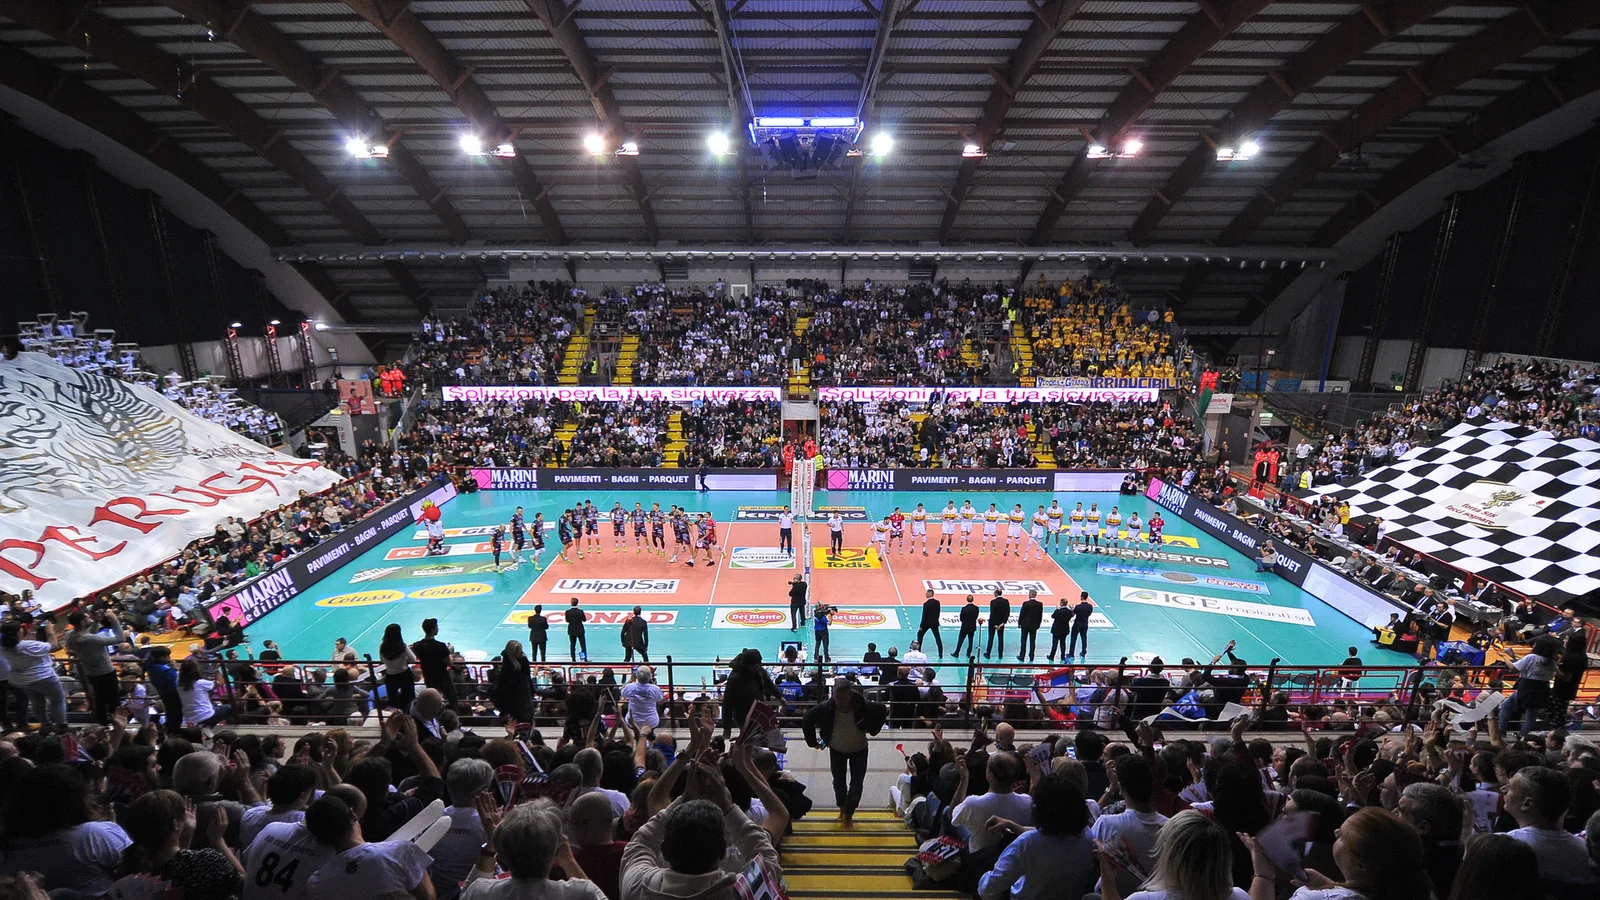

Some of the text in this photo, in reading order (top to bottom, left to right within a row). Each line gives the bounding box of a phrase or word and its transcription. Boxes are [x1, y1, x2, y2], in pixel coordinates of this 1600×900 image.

[1091, 377, 1179, 389] IRRIDUCIBILI
[449, 387, 775, 401] Soluzioni per la tua sicurezza
[825, 388, 926, 400] Soluzioni
[982, 388, 999, 400] la
[1005, 388, 1040, 400] tua
[1047, 388, 1152, 400] sicurezza
[491, 469, 538, 482] MARINI
[554, 475, 601, 483] PAVIMENTI
[611, 475, 639, 483] BAGNI
[649, 475, 690, 484] PARQUET
[848, 470, 894, 483] MARINI
[911, 476, 959, 484] PAVIMENTI
[968, 476, 996, 484] BAGNI
[1006, 476, 1048, 485] PARQUET
[491, 481, 538, 489] edilizia
[1160, 482, 1189, 509] MARINI
[0, 461, 321, 590] PERUGIA
[462, 526, 500, 535] GLS
[306, 542, 350, 574] PAVIMENTI
[353, 526, 377, 547] BAGNI
[381, 508, 409, 531] PARQUET
[1193, 508, 1228, 533] PAVIMENTI
[1232, 529, 1256, 548] BAGNI
[1275, 554, 1302, 573] QUET
[395, 549, 422, 557] PC
[824, 561, 871, 569] Todis
[236, 567, 294, 612] MARINI
[419, 584, 483, 598] Colussi
[558, 579, 675, 593] UnipolSai
[926, 580, 1046, 594] UnipolSai
[245, 586, 298, 622] edilizia
[327, 592, 395, 605] Colussi
[1164, 593, 1311, 622] IGE impianti srl
[749, 613, 782, 621] Monte
[848, 614, 881, 622] Monte
[255, 851, 300, 894] 84
